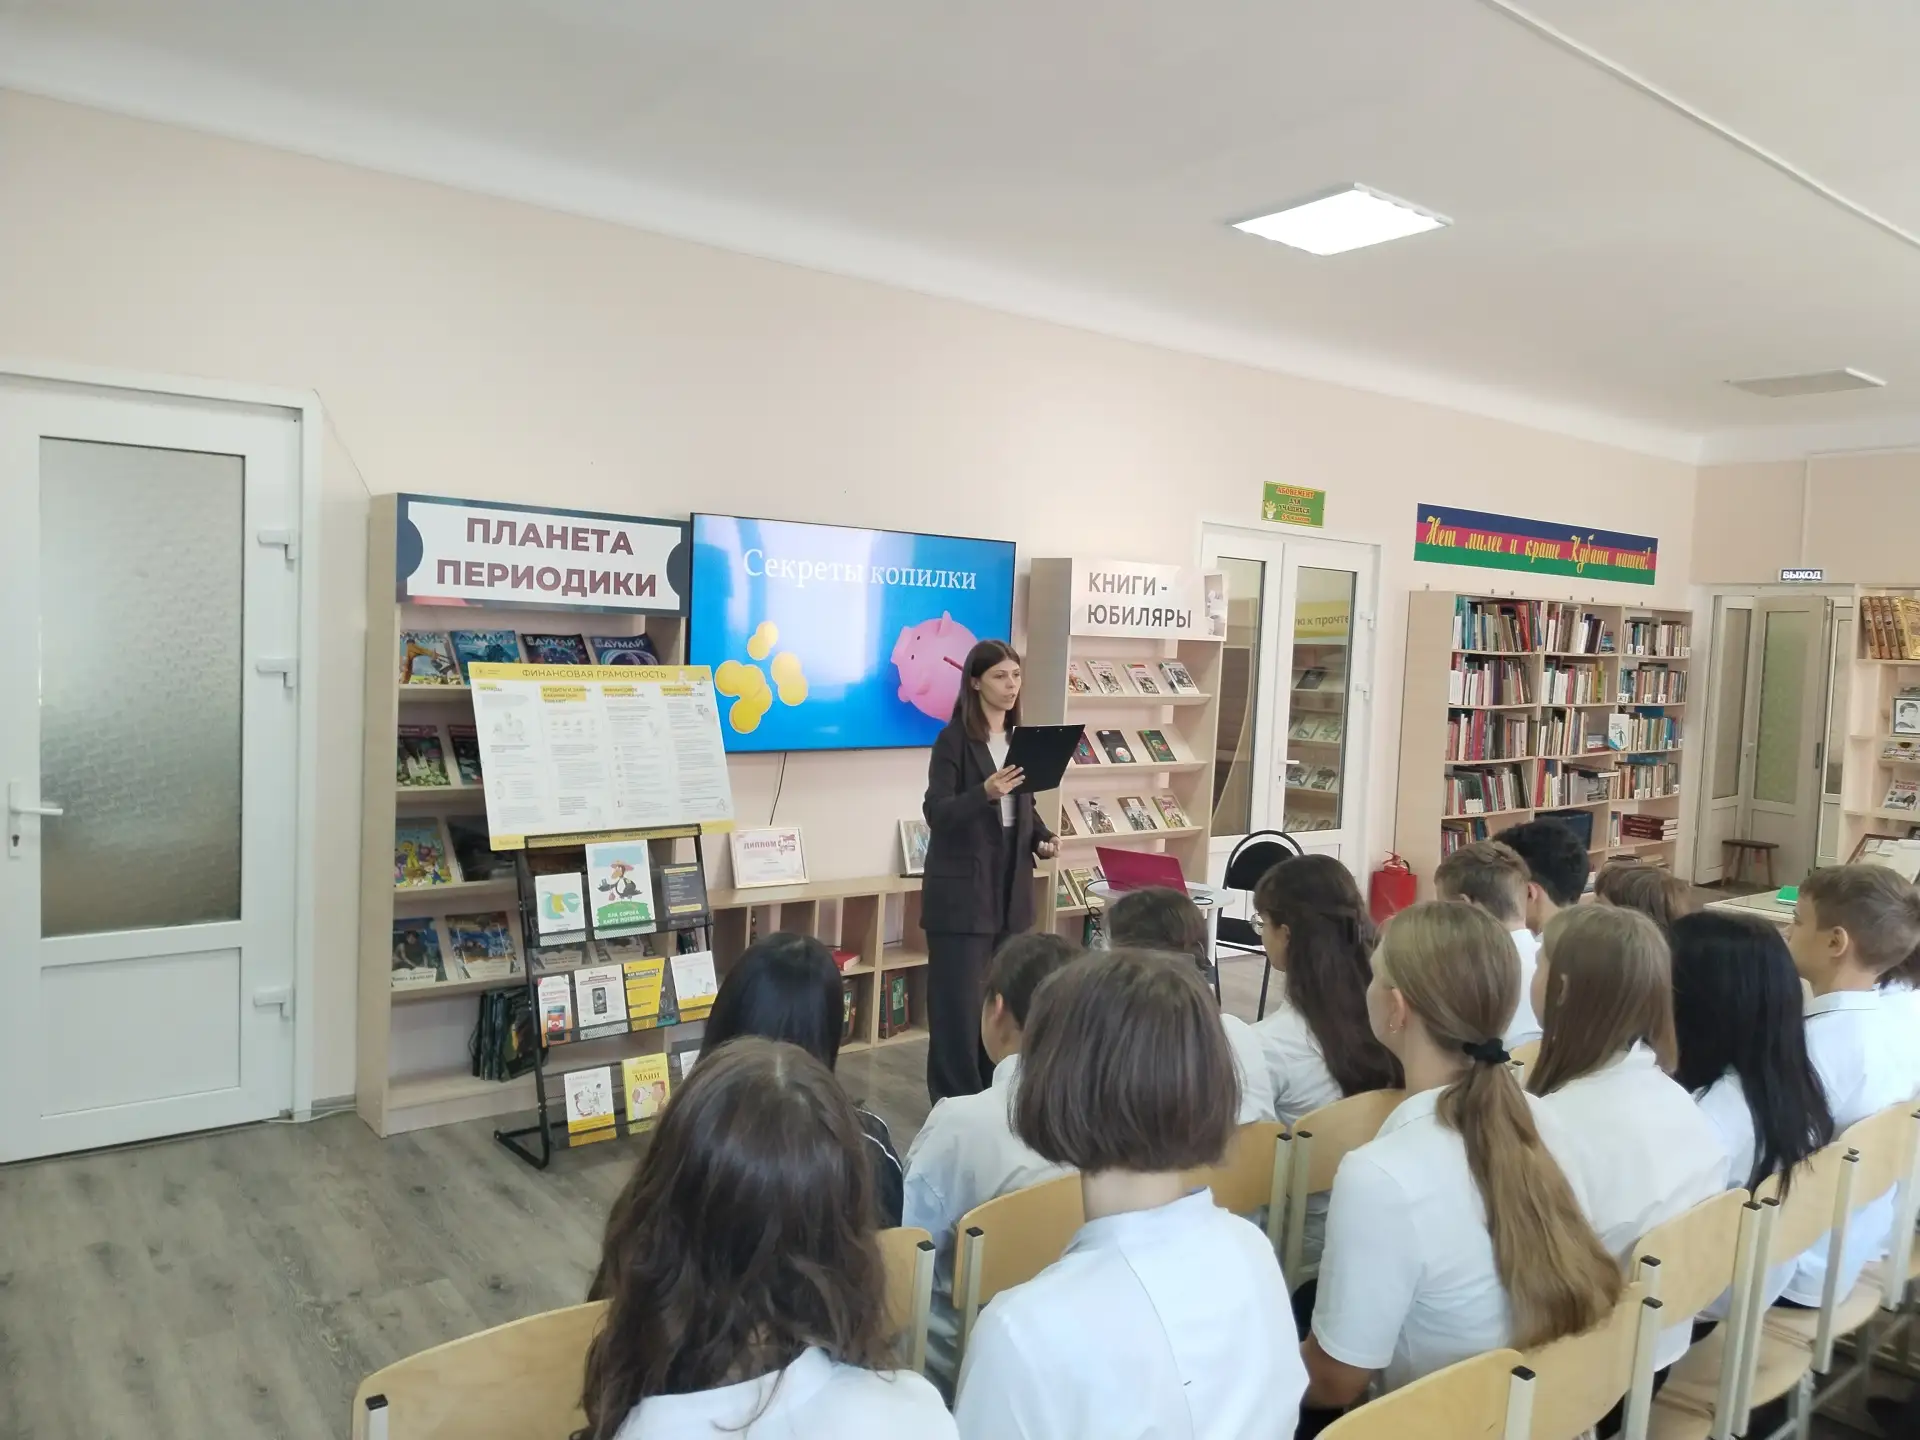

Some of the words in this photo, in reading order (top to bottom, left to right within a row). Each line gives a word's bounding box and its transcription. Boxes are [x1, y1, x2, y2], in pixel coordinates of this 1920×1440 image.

[466, 517, 634, 556] ПЛАНЕТА
[1426, 515, 1457, 547] Нет
[1464, 533, 1503, 553] милее
[1509, 539, 1518, 555] и
[1524, 539, 1560, 564] краше
[1568, 534, 1609, 574] Кубани
[436, 559, 657, 598] ПЕРИОДИКИ
[743, 548, 863, 588] Секреты
[870, 565, 977, 590] копилки
[1782, 570, 1822, 580] ВЫХОД
[1088, 572, 1156, 596] КНИГИ
[1087, 604, 1192, 629] ЮБИЛЯРЫ
[522, 669, 594, 679] ФИНАНСОВАЯ
[597, 670, 667, 680] ГРАМОТНОСТЬ
[743, 840, 777, 850] ДИПЛОМ
